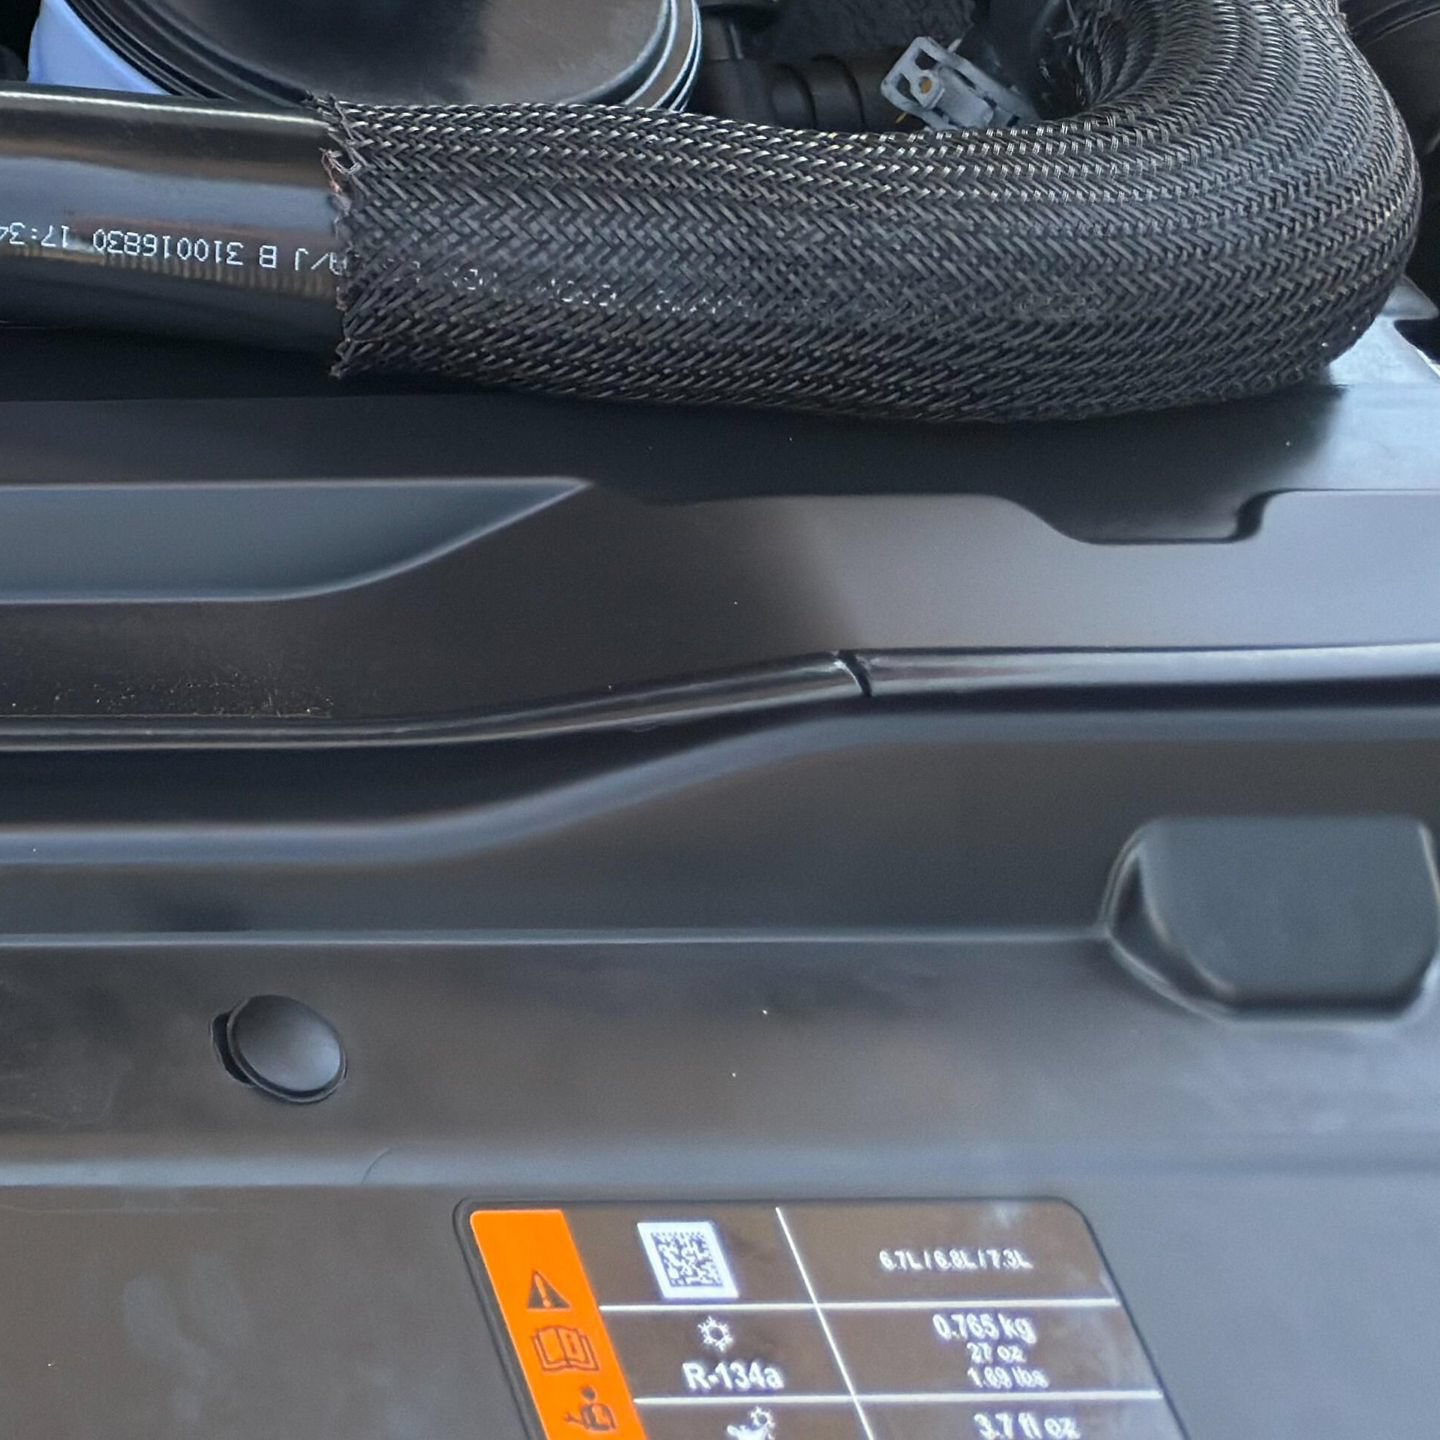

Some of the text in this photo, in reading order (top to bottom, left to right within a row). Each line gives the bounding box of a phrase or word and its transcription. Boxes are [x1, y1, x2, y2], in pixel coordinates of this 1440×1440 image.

[93, 228, 244, 266] 310016830
[258, 244, 277, 269] B
[932, 1315, 1037, 1345] 0.765 kg
[994, 1345, 1026, 1363] oz
[682, 1363, 783, 1390] R-134a
[1009, 1367, 1049, 1390] lbs
